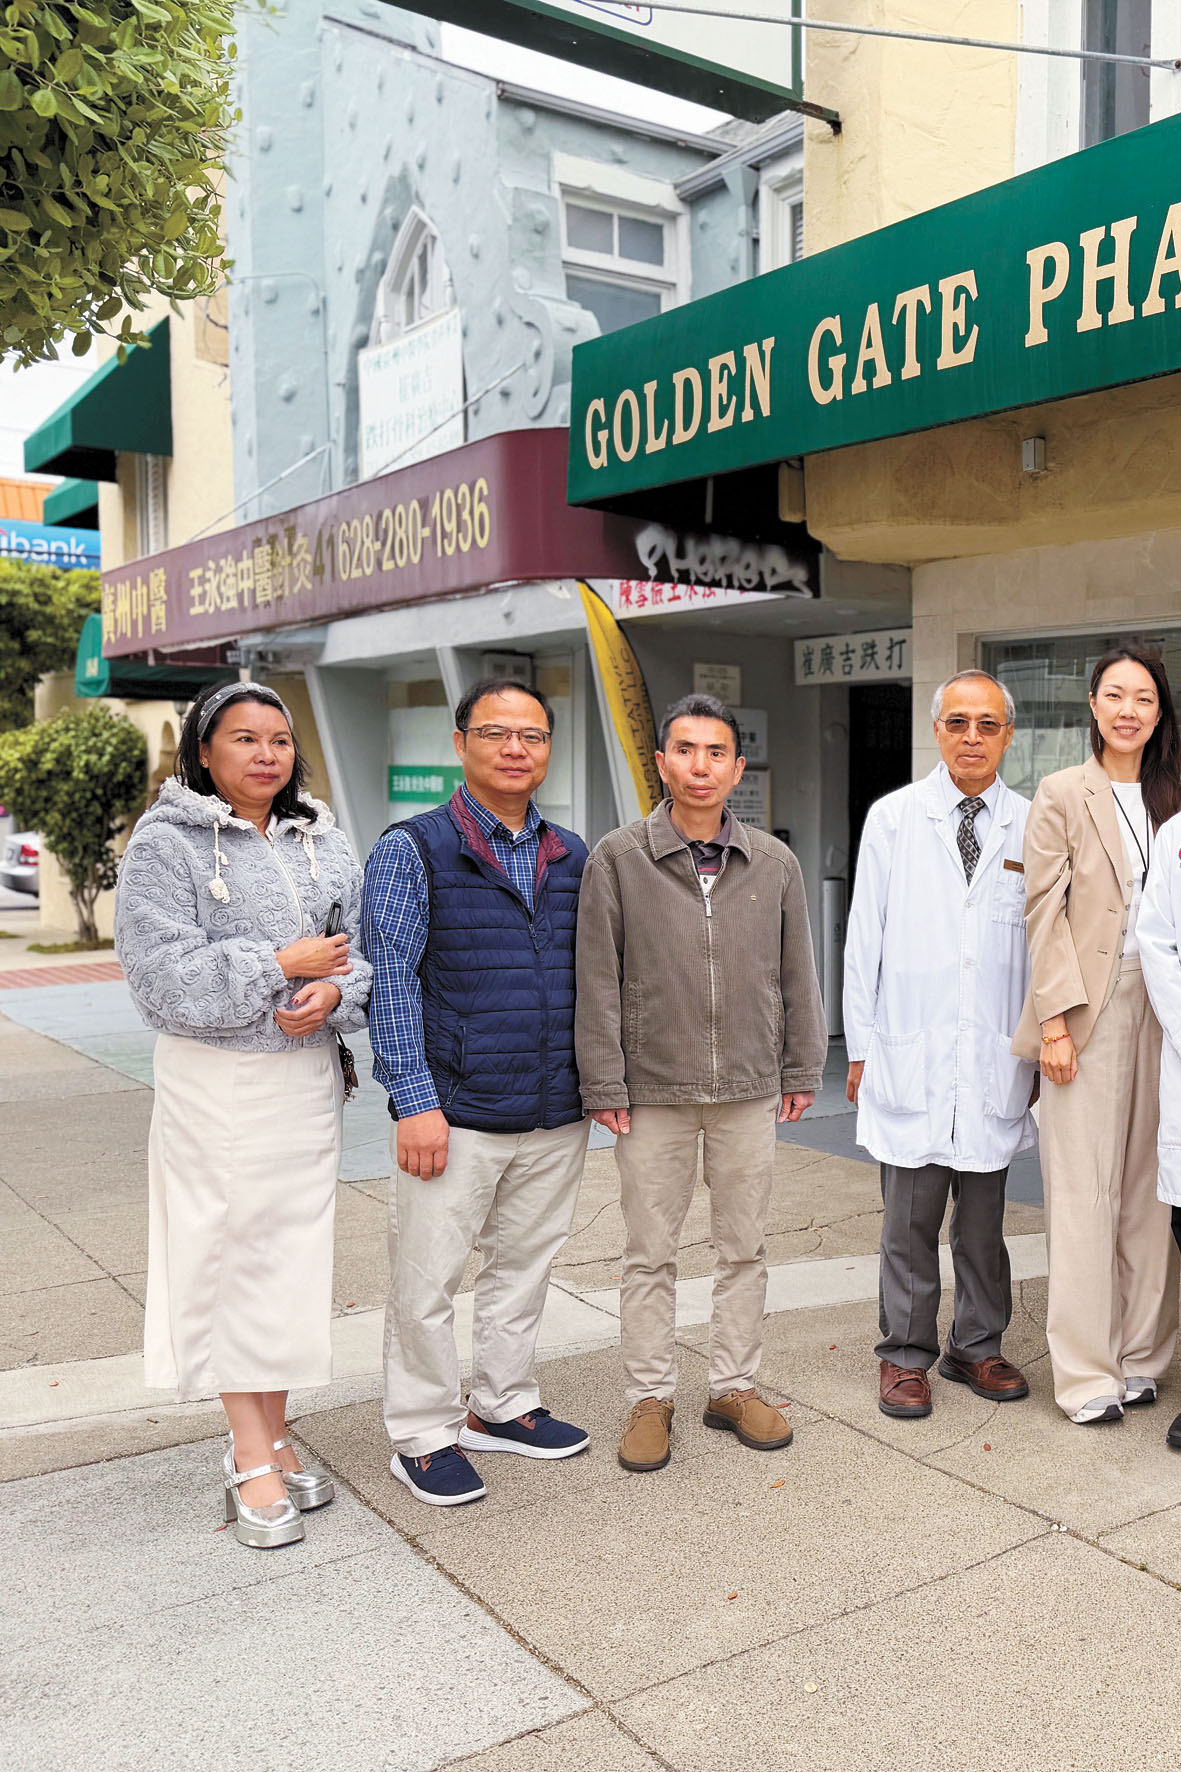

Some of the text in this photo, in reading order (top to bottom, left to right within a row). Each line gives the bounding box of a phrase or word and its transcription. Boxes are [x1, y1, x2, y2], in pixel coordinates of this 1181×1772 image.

[585, 336, 776, 470] GOLDEN
[807, 269, 980, 405] GATE
[338, 477, 489, 582] 628-280-1936
[802, 637, 907, 678] 崔廣吉跌打
